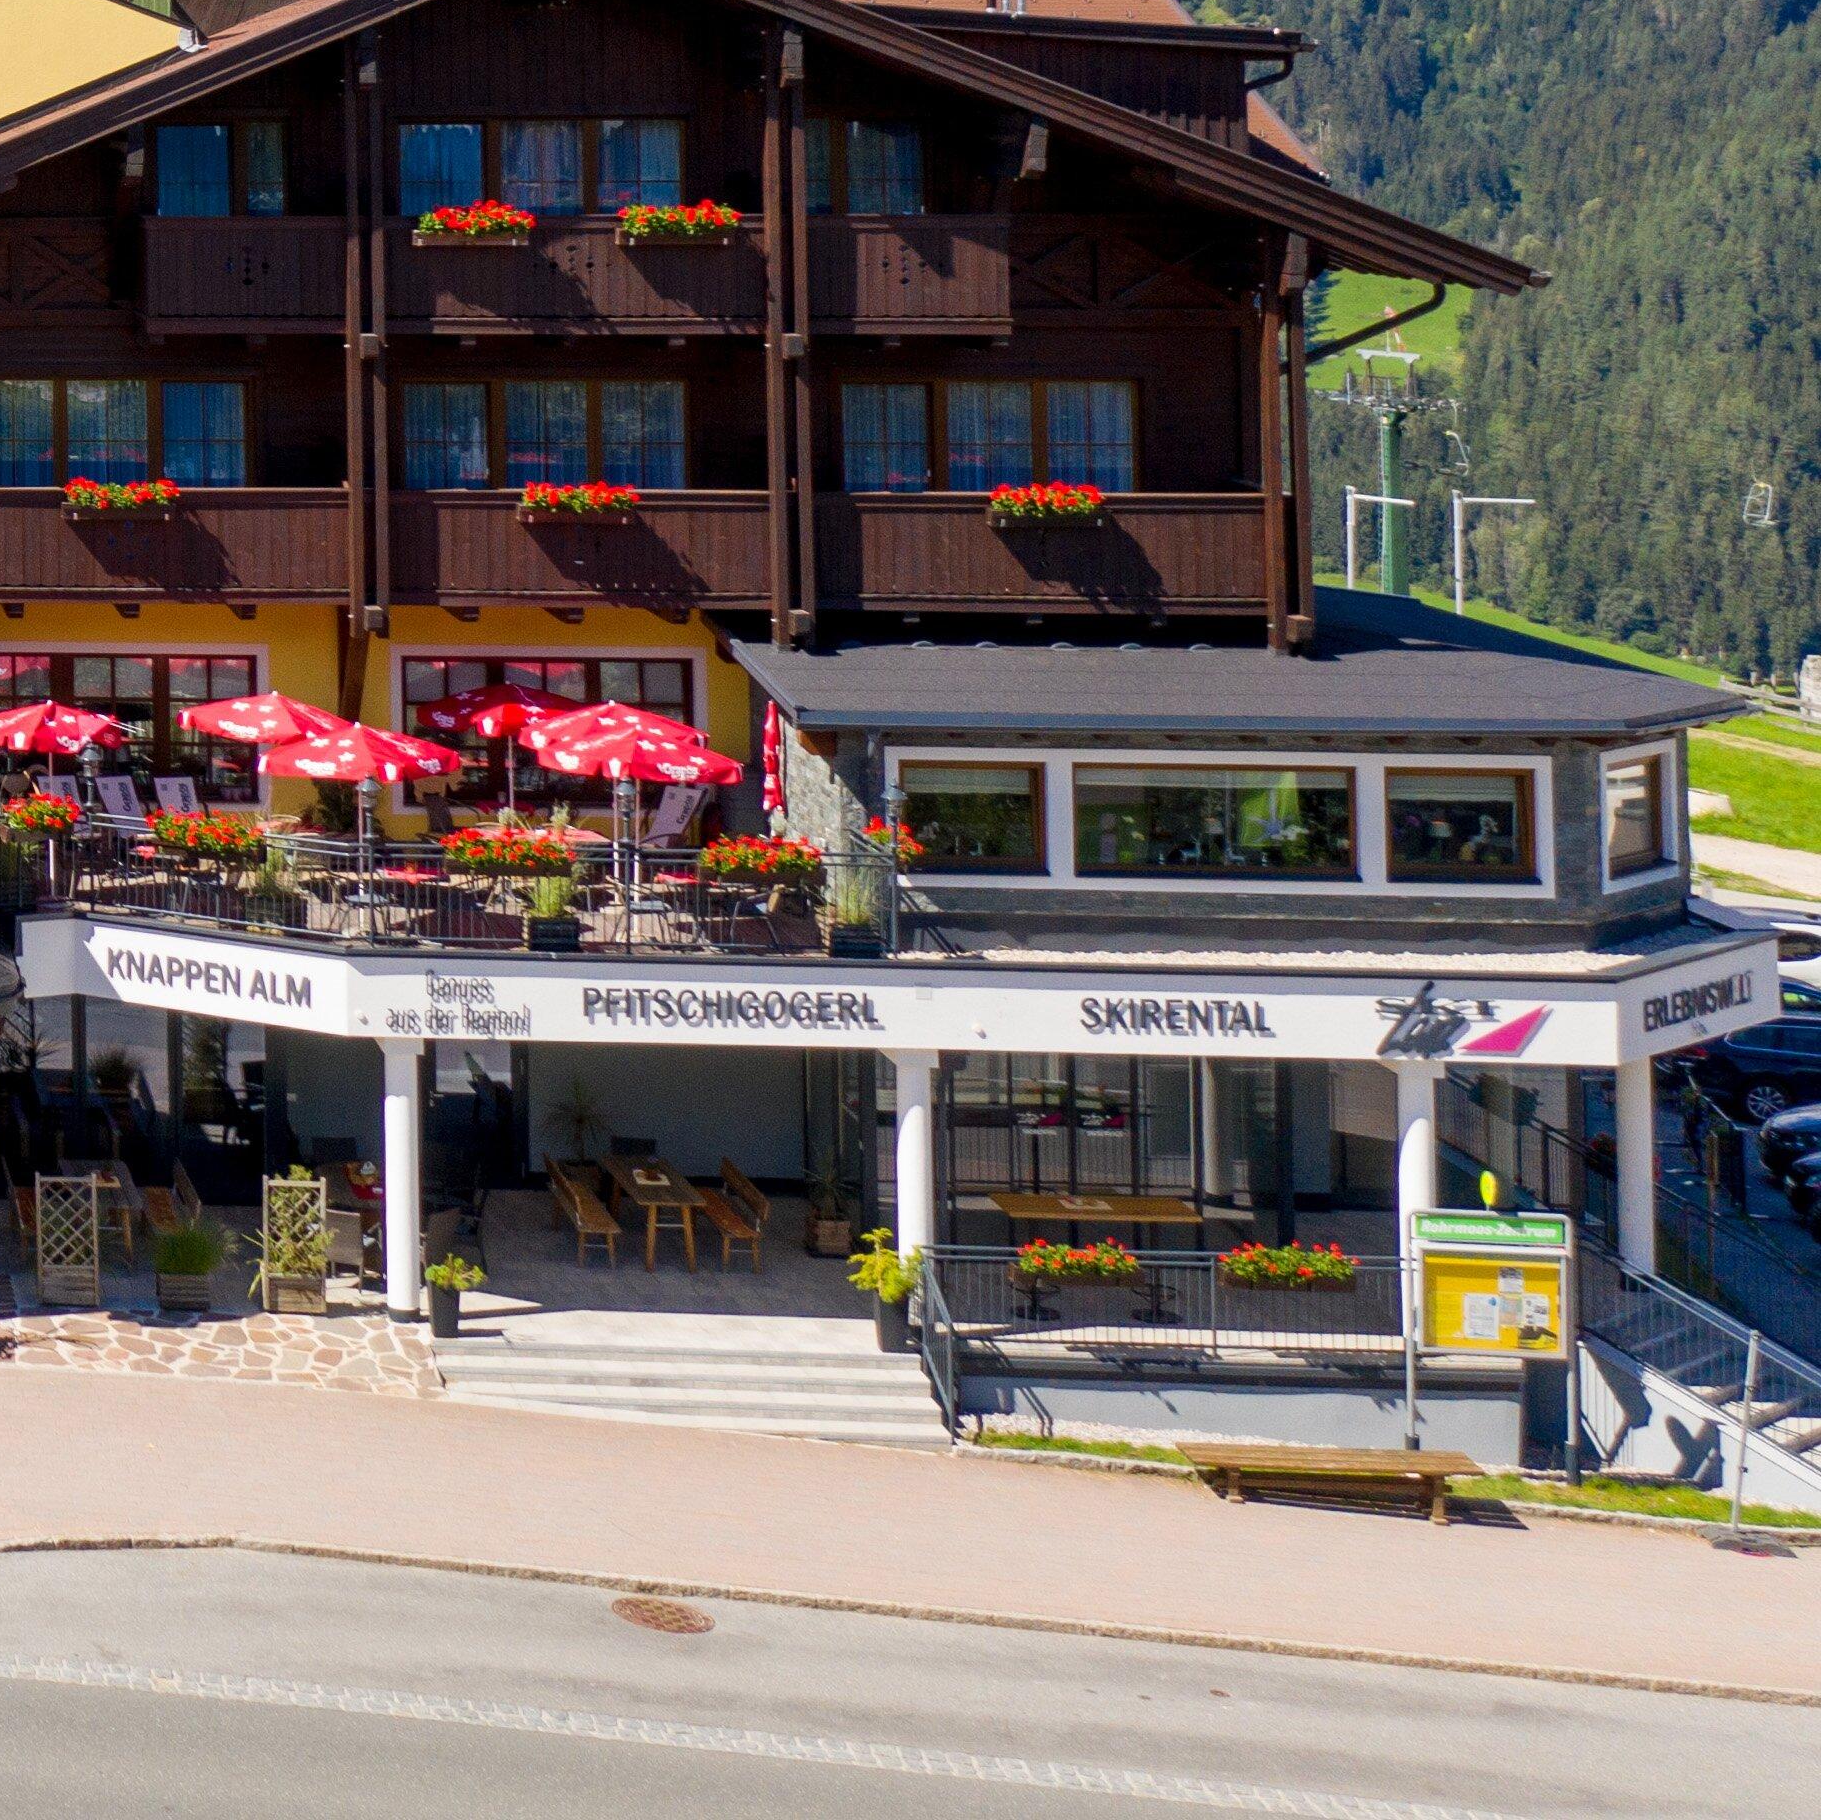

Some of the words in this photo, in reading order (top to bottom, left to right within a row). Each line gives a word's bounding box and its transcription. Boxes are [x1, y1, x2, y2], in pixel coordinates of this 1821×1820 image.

[106, 945, 242, 998] KNAPPEN
[248, 967, 312, 1009] ALM
[582, 976, 881, 1024] PFITSCHIGOGERL
[1079, 997, 1273, 1033] SKIRENTAL
